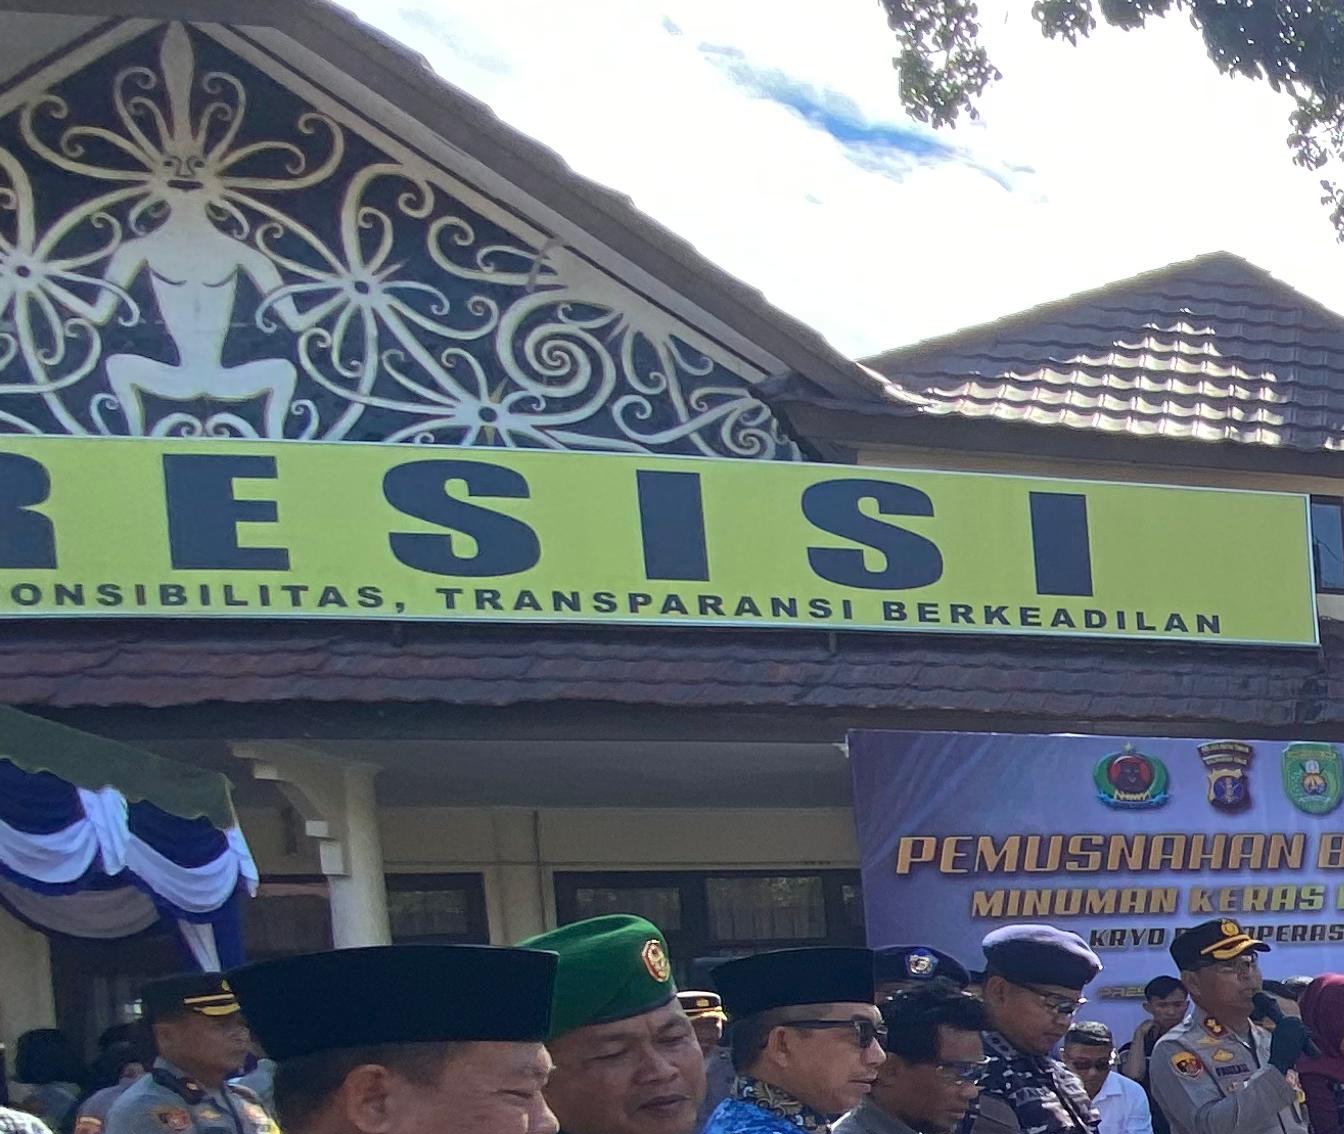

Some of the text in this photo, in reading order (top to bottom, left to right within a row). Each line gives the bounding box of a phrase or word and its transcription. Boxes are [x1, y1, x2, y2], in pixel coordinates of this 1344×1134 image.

[436, 587, 853, 621] TRANSPARANSI
[882, 600, 1221, 635] BERKEADILAN
[896, 832, 1306, 875] PEMUSNAHAN
[971, 888, 1180, 918] MINUMAN
[1189, 884, 1324, 915] KERAS
